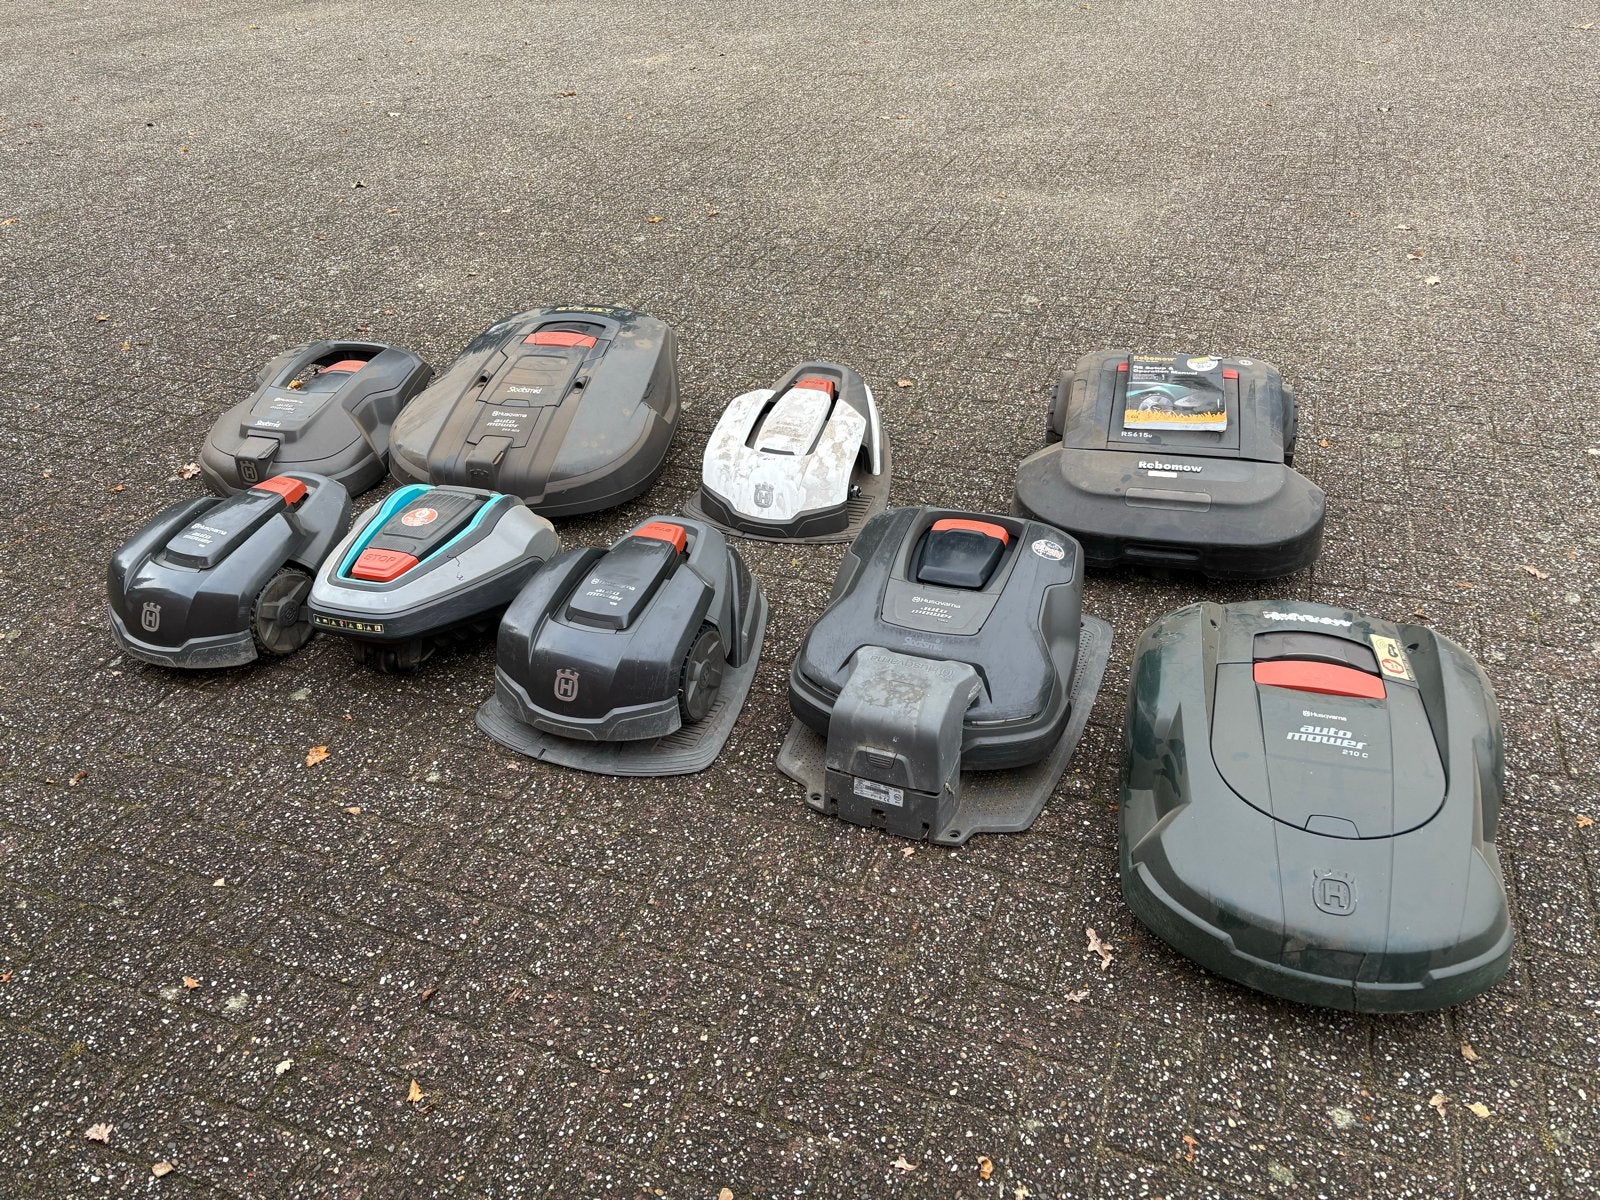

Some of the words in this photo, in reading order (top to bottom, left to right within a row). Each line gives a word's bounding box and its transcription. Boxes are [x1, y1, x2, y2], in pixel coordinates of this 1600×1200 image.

[1138, 460, 1203, 473] Robomow
[363, 553, 397, 563] STOP
[920, 597, 961, 609] Husqvarna
[1310, 711, 1347, 721] Husqvarna
[1300, 725, 1352, 739] auto
[1286, 731, 1367, 750] mower
[1342, 749, 1360, 757] 210
